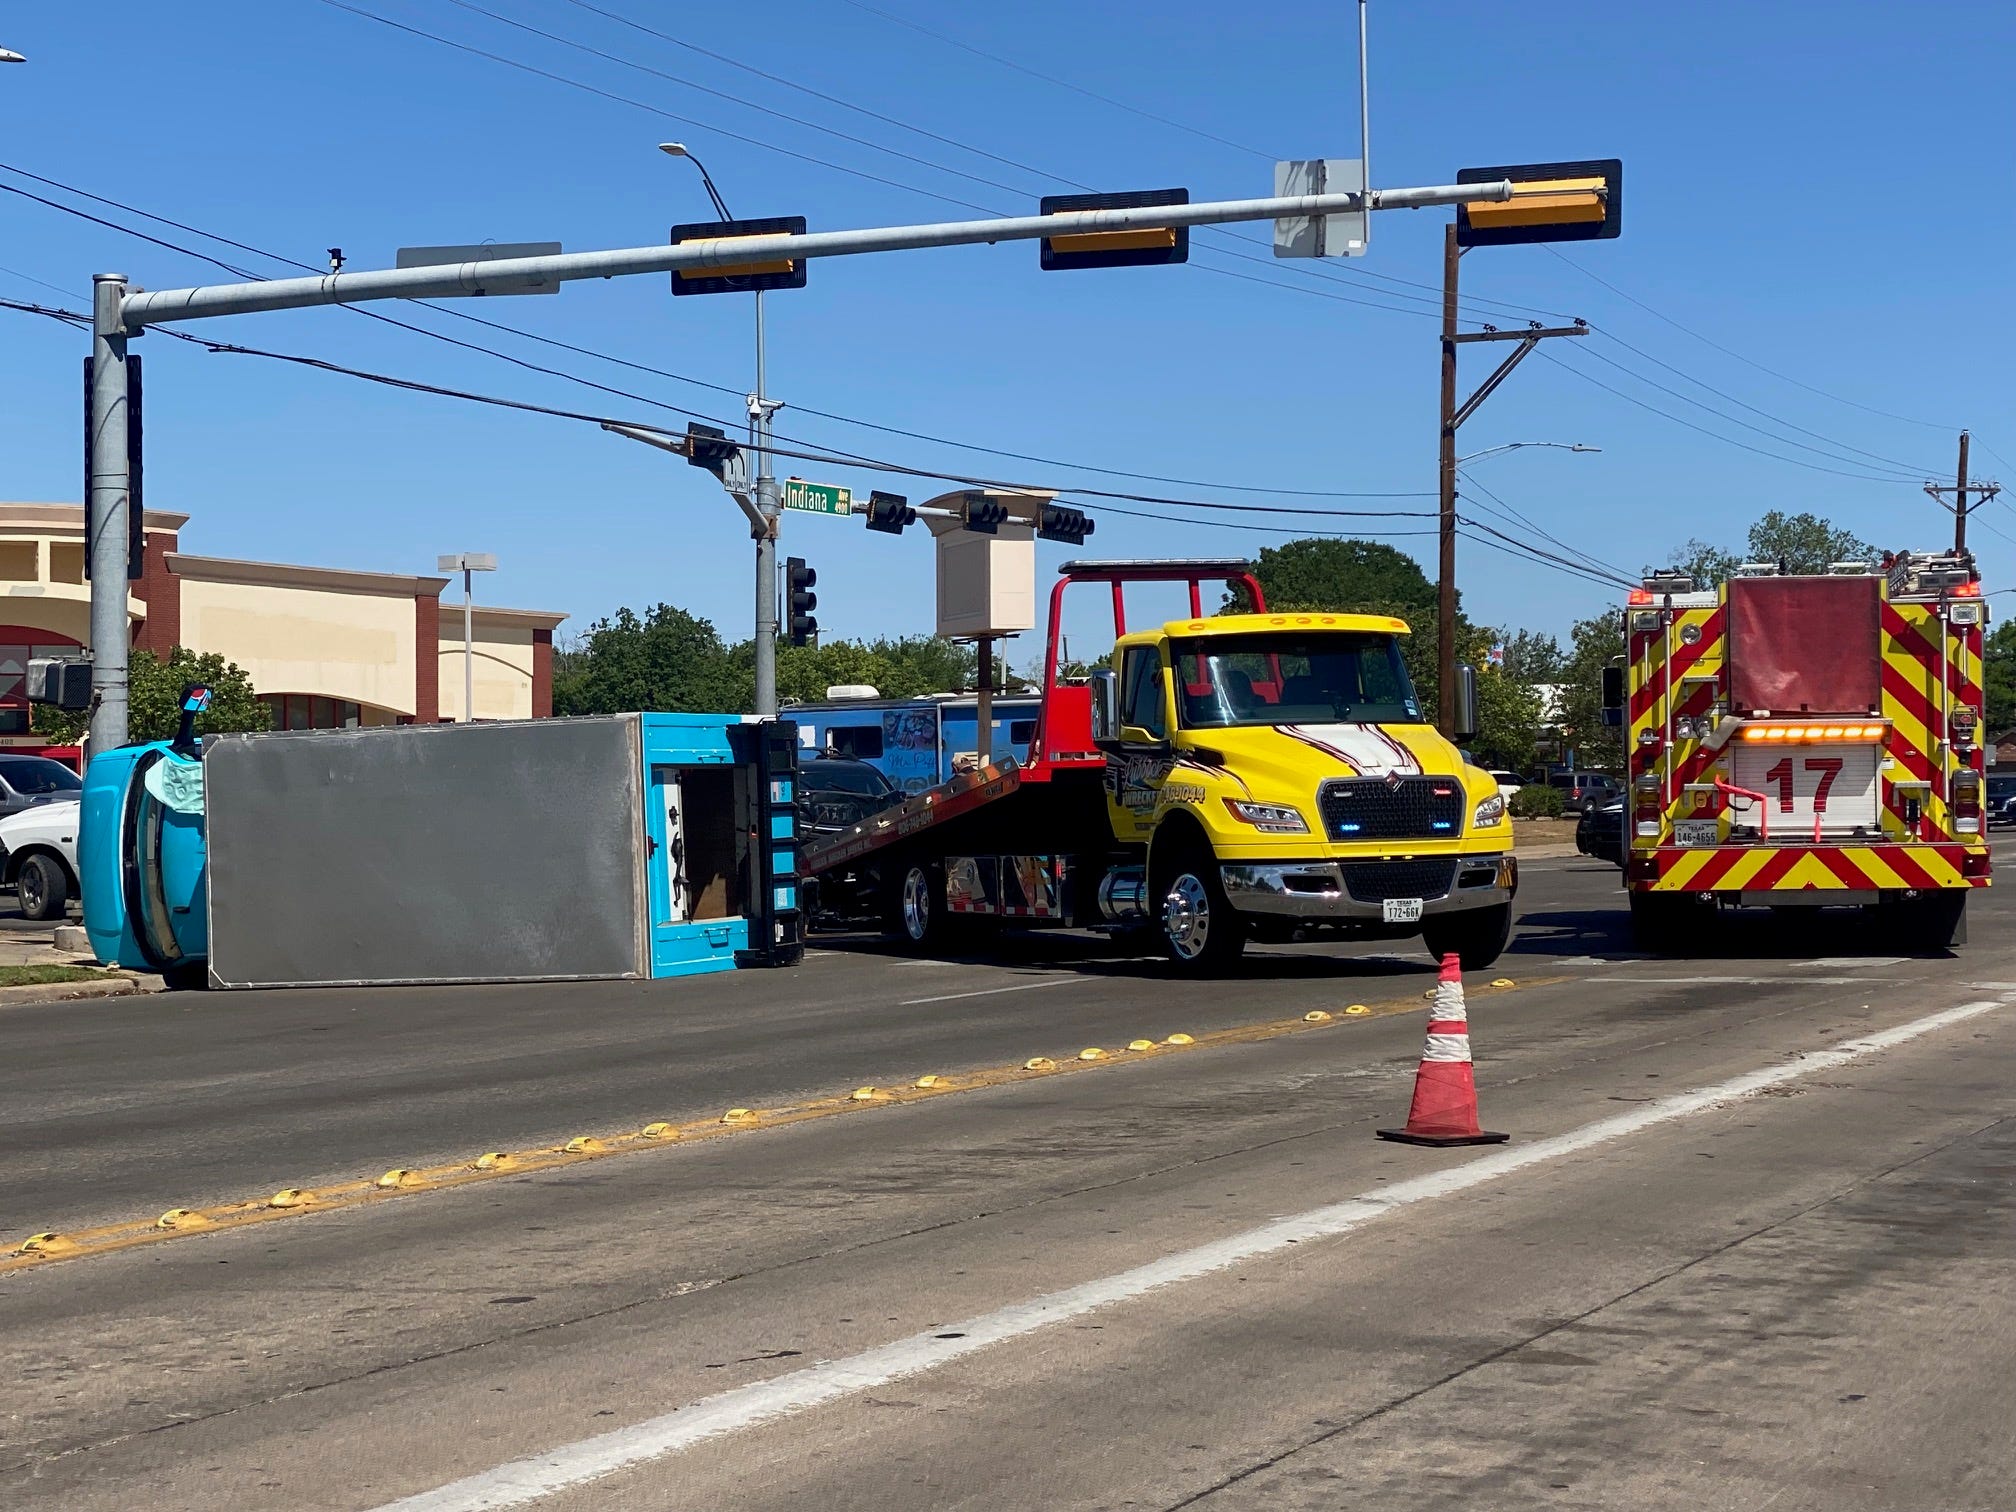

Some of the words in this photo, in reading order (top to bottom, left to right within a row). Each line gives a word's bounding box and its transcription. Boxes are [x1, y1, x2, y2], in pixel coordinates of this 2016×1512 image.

[787, 485, 828, 511] Indiana
[838, 489, 849, 502] Ave
[834, 502, 848, 515] 4900
[1766, 757, 1843, 813] 17
[1677, 832, 1716, 842] 146-4655
